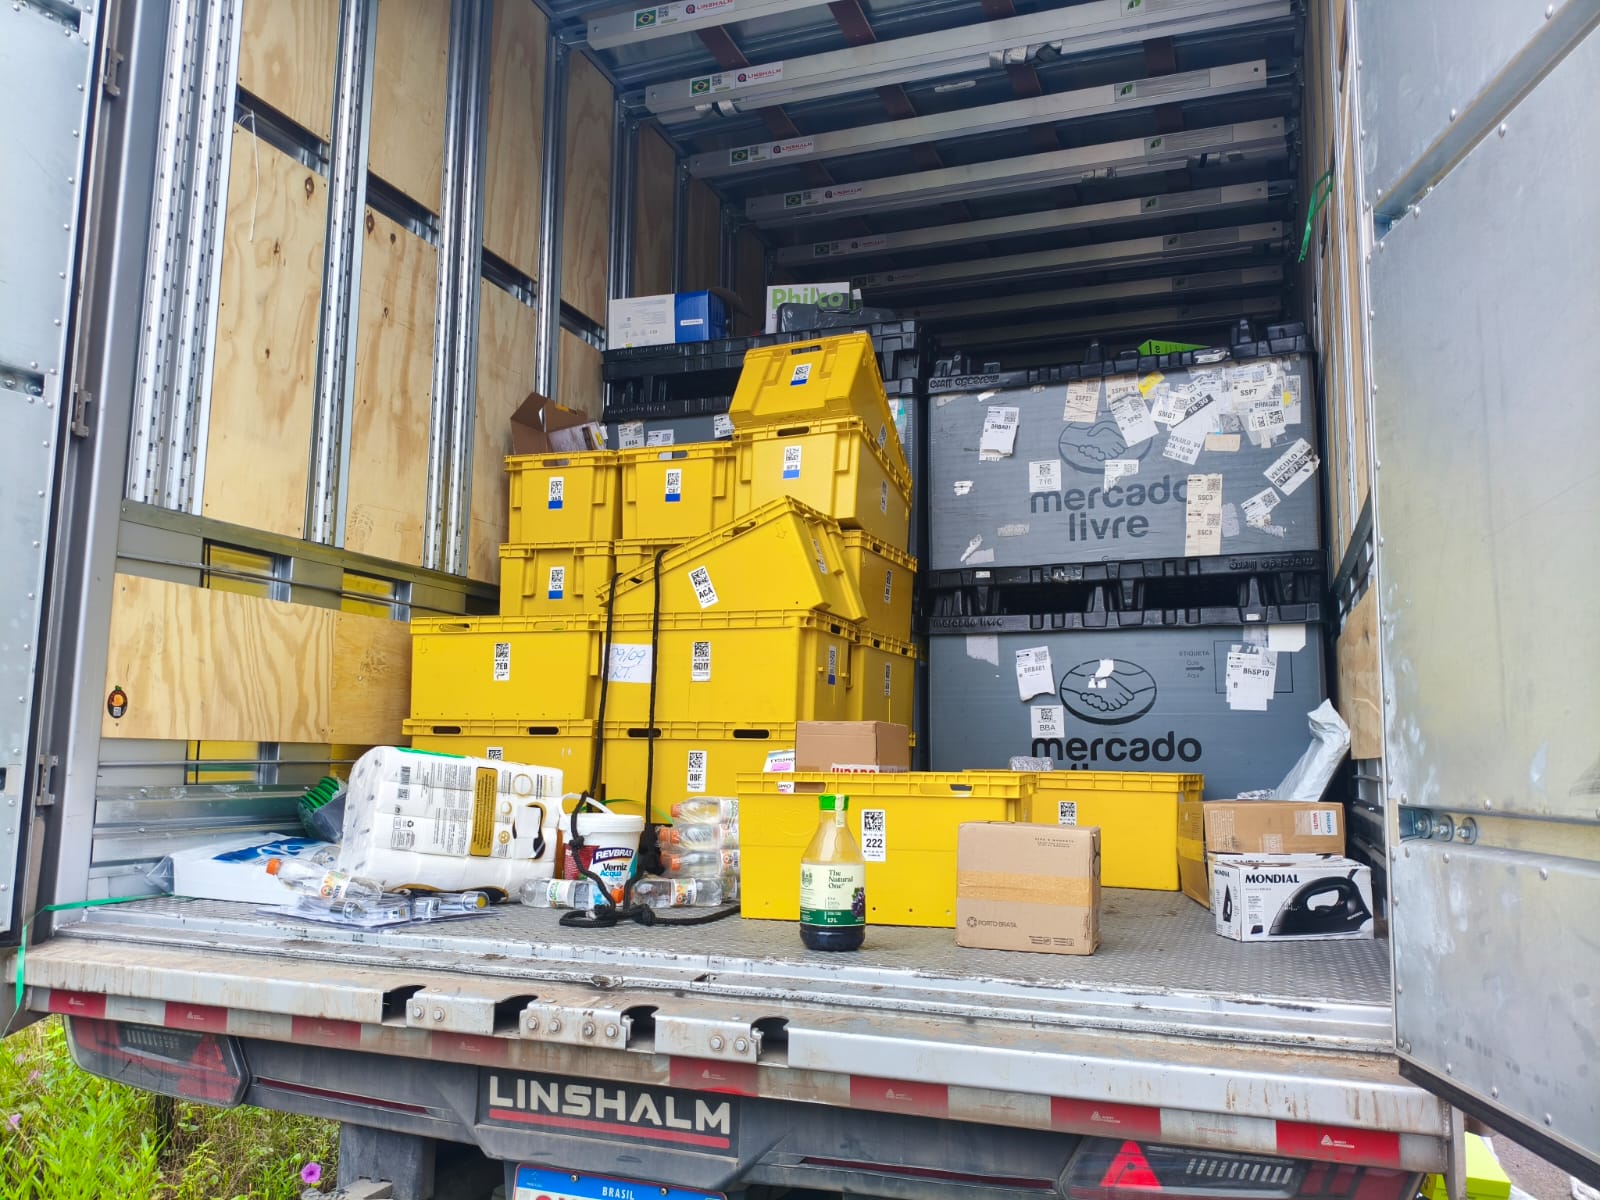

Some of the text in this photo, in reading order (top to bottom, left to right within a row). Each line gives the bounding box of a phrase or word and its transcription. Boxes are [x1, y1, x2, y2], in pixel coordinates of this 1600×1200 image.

[747, 68, 782, 79] LINSHALM
[782, 141, 813, 151] LINSHALM
[772, 287, 844, 310] Philco
[1031, 474, 1188, 513] mercado
[1069, 512, 1149, 541] livre
[698, 587, 714, 600] ACA
[1031, 731, 1202, 762] mercado
[866, 838, 883, 848] 222
[596, 849, 632, 860] REVBRAS
[603, 863, 628, 871] Verniz
[828, 875, 853, 883] Natural
[1245, 874, 1300, 884] MONDIAL
[489, 1075, 730, 1135] LINSHALM
[602, 1186, 634, 1200] BRASIL
